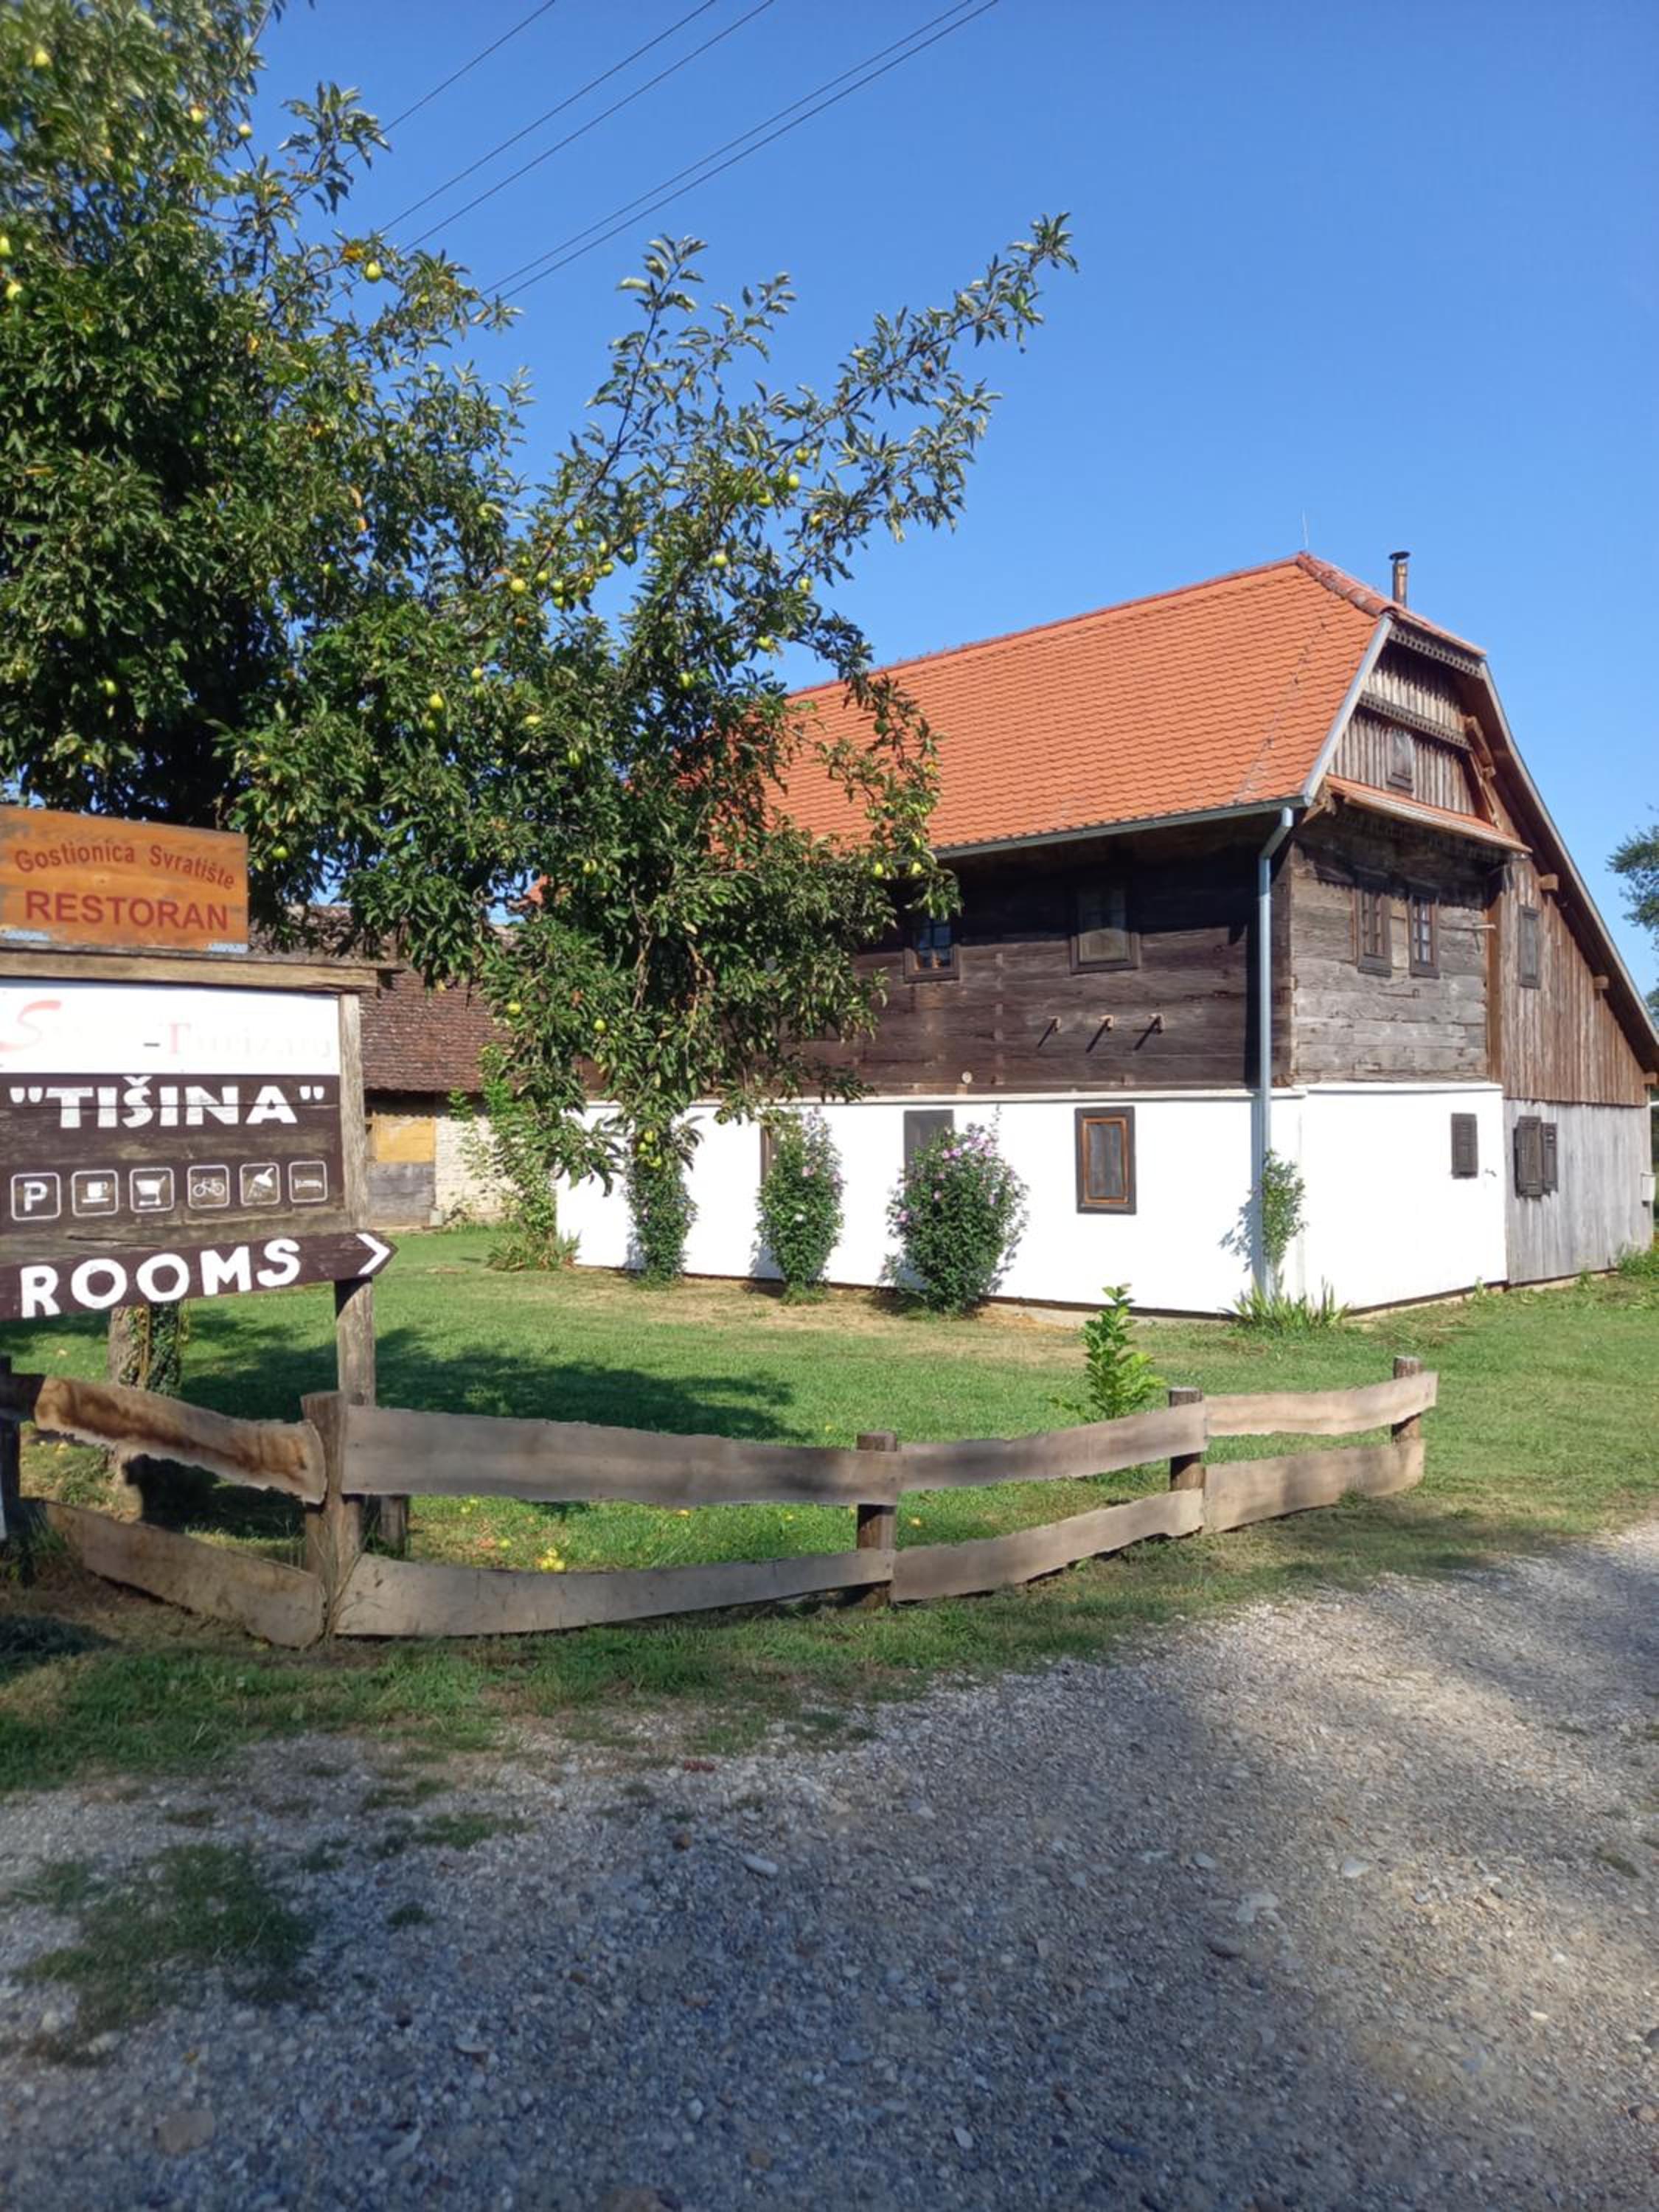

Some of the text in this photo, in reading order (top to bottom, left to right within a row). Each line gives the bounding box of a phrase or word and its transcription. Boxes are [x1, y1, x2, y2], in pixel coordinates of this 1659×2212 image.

[15, 840, 235, 889] Gostionica Svratište
[24, 890, 228, 931] RESTORAN
[10, 1076, 324, 1128] "TIŠINA"
[24, 1182, 47, 1211] P
[20, 1238, 301, 1318] ROOMS
